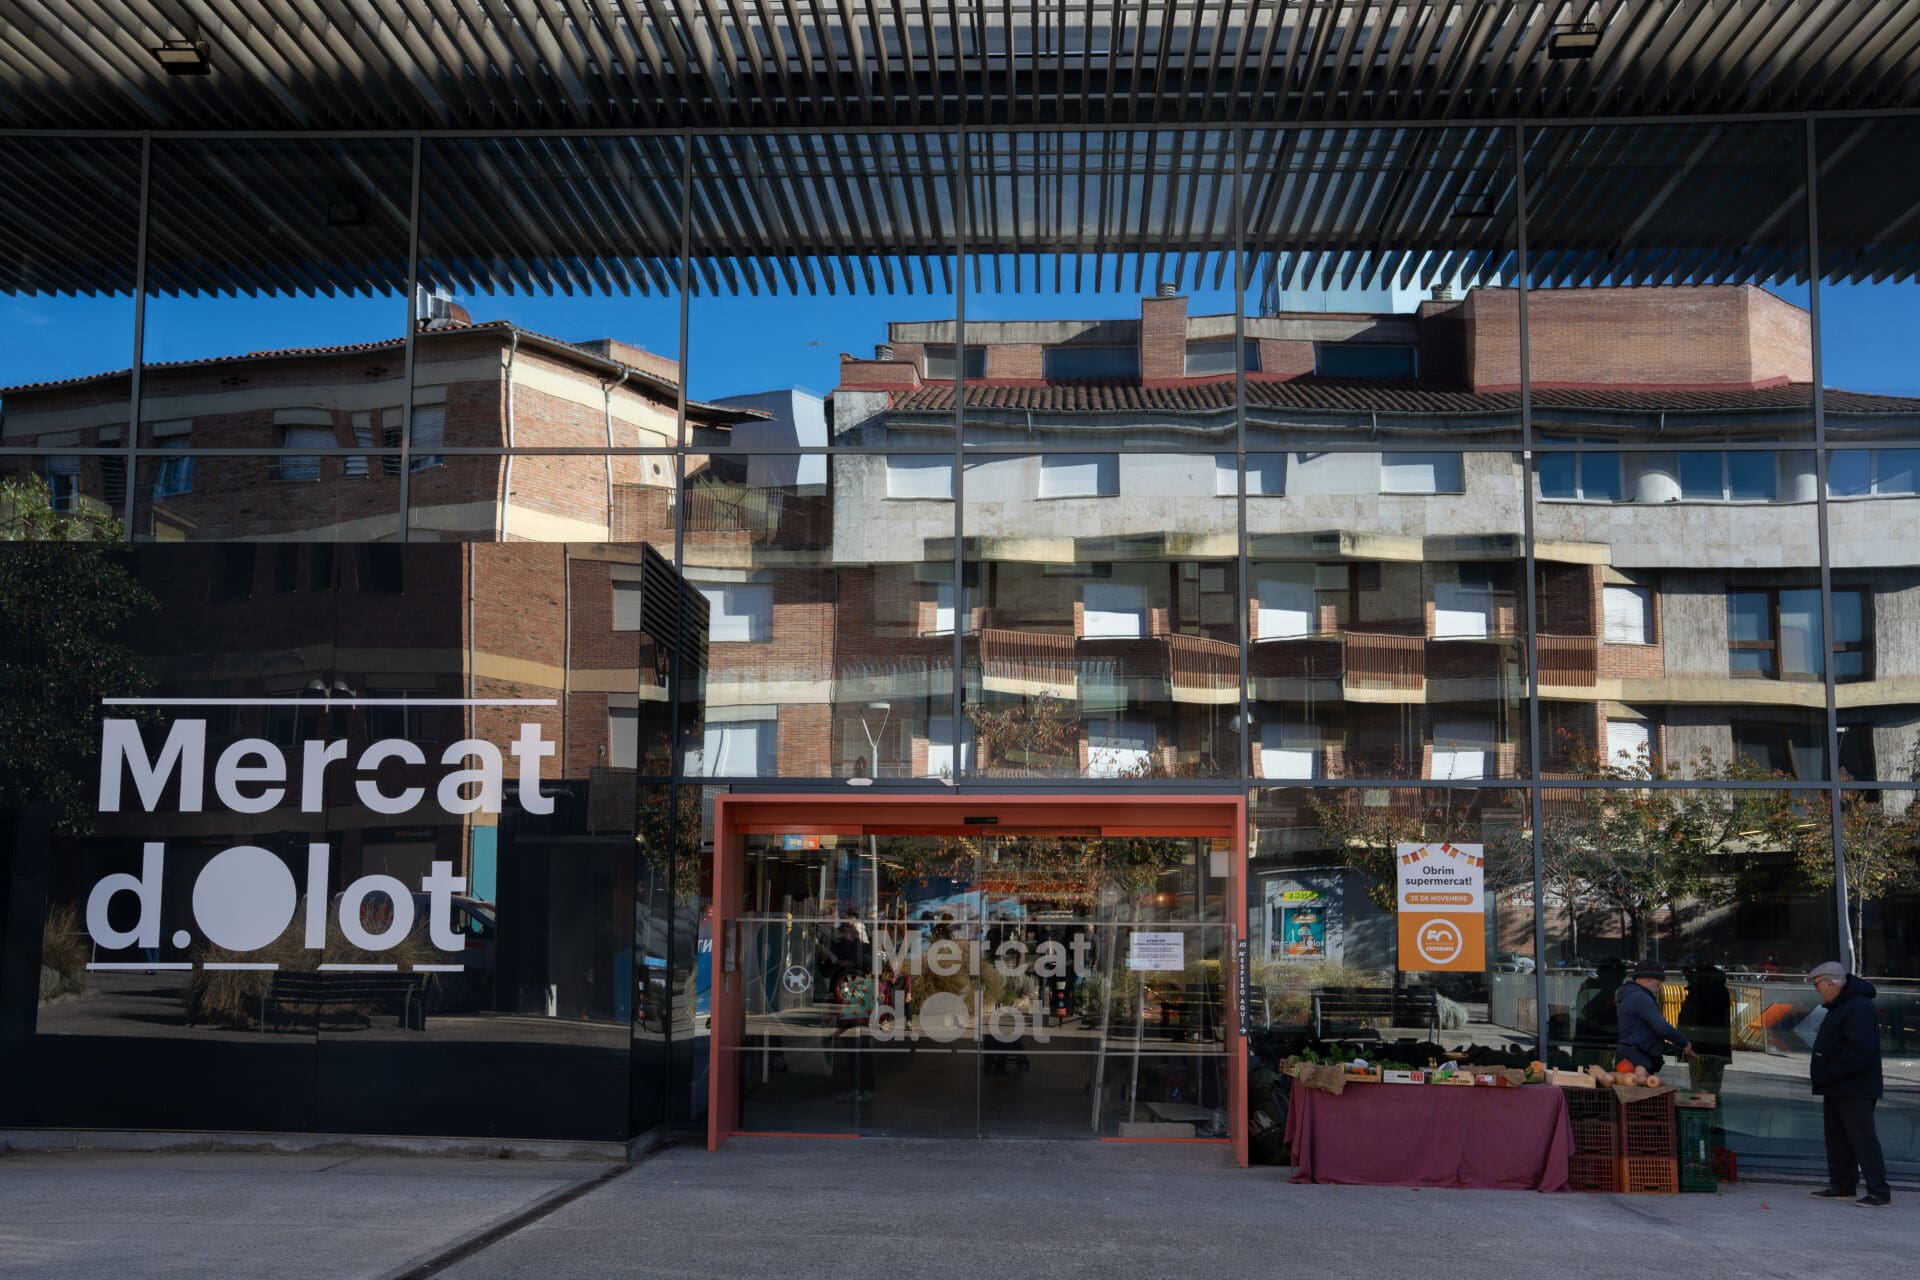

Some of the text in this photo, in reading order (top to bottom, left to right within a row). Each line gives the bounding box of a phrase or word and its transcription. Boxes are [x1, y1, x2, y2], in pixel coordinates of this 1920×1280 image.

[98, 719, 556, 815] Mercat
[1405, 876, 1472, 887] supermercat!
[1422, 866, 1455, 875] Obrim
[871, 929, 1092, 978] Mercat
